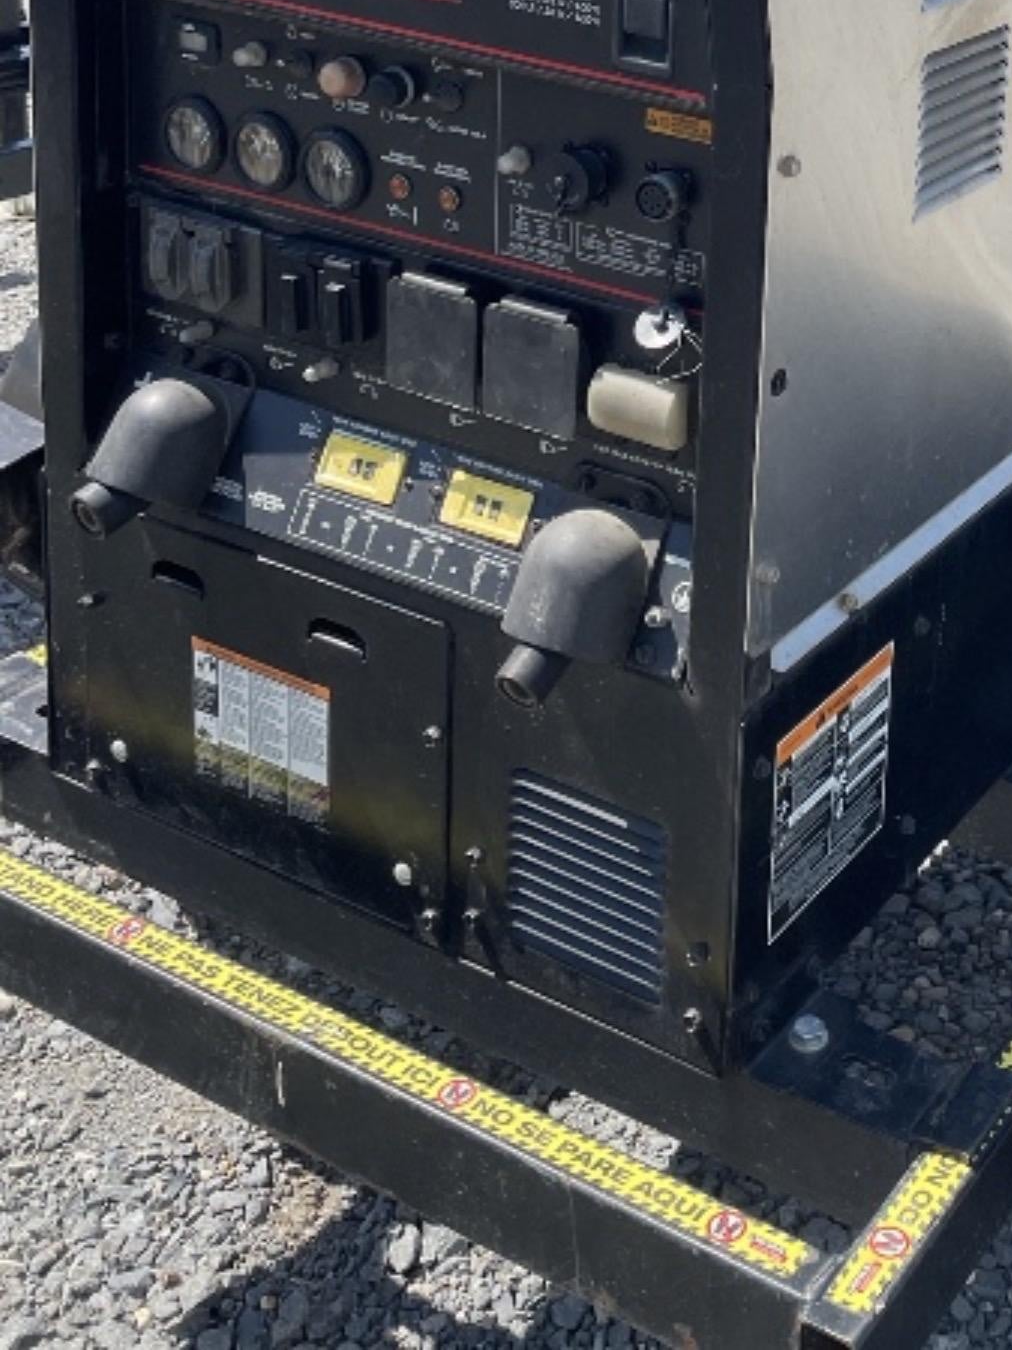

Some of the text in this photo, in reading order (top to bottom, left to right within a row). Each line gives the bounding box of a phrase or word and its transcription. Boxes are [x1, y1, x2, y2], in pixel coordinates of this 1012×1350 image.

[138, 934, 172, 959] NE
[175, 948, 222, 980] PAS
[222, 970, 303, 1022] TENEZ
[400, 1064, 442, 1088] ICI
[472, 1098, 513, 1127] NO
[515, 1121, 551, 1147] SE
[556, 1137, 630, 1186] PARE
